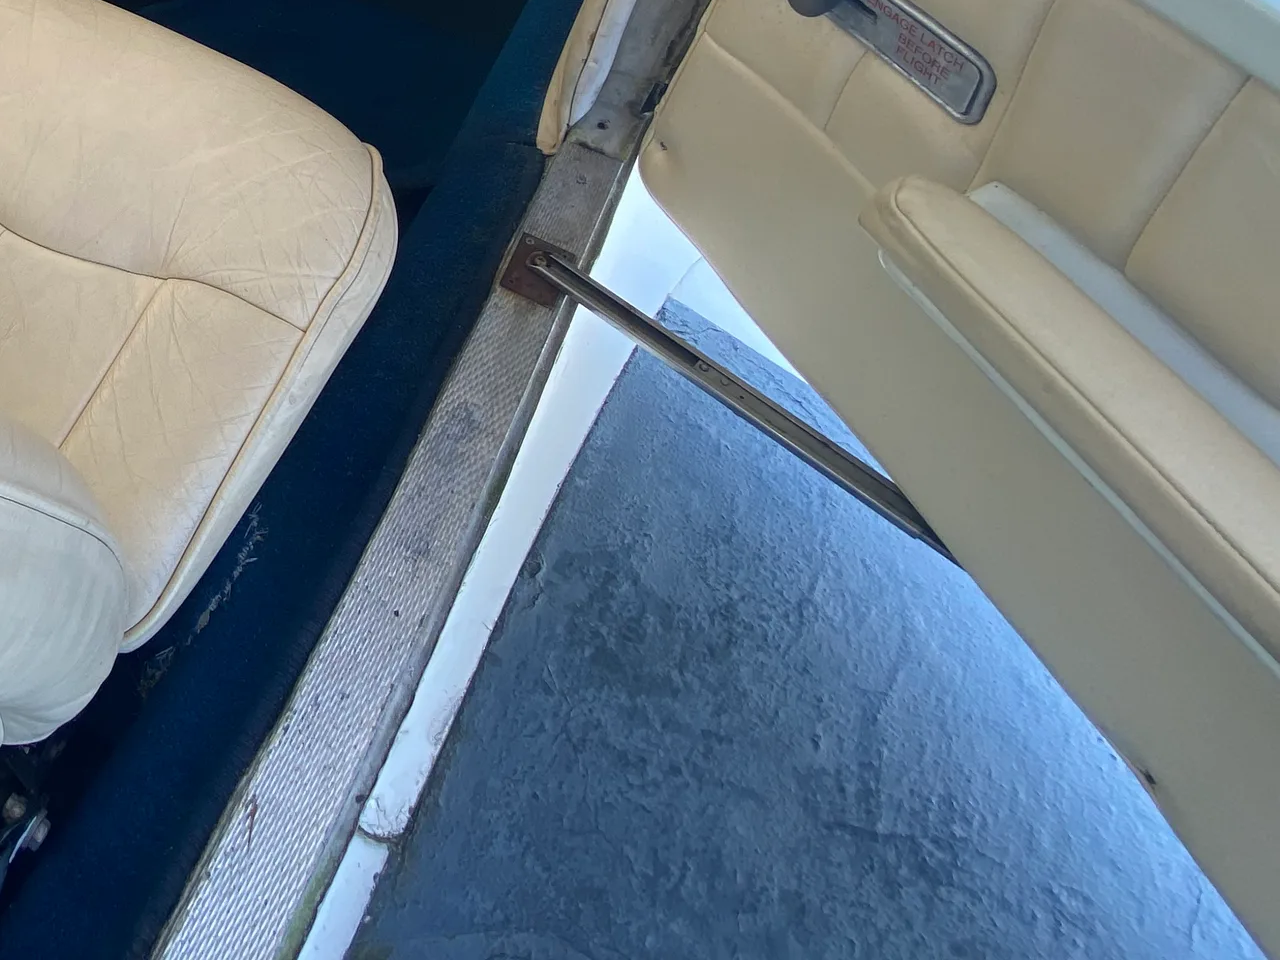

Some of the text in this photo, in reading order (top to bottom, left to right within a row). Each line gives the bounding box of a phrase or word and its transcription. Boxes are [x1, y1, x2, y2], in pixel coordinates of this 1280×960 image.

[896, 45, 942, 85] FLIGHT
[898, 32, 951, 81] BEFORE
[920, 32, 965, 72] LATCH
